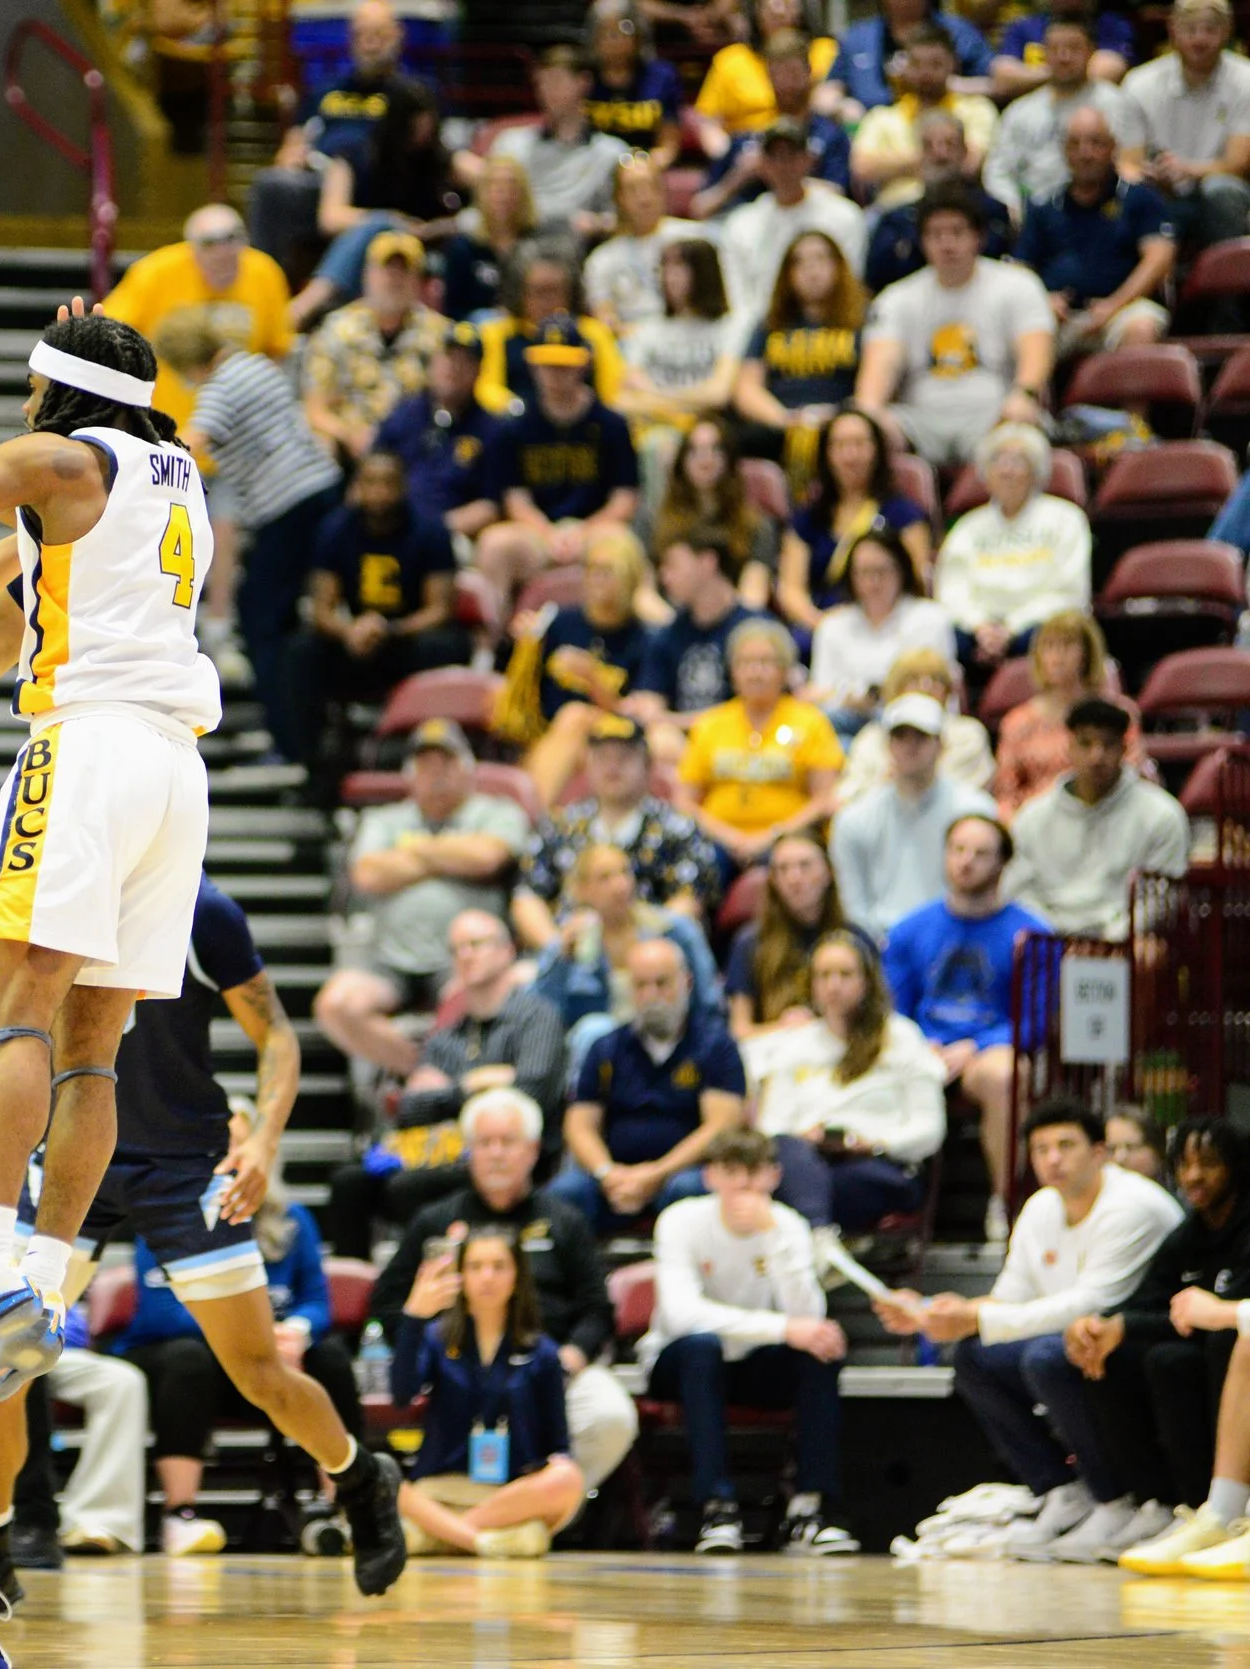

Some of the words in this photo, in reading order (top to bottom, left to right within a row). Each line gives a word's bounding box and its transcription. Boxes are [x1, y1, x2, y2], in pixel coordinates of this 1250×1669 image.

[150, 454, 191, 492] SMITH
[158, 502, 195, 609] 4
[7, 739, 52, 871] BUCS
